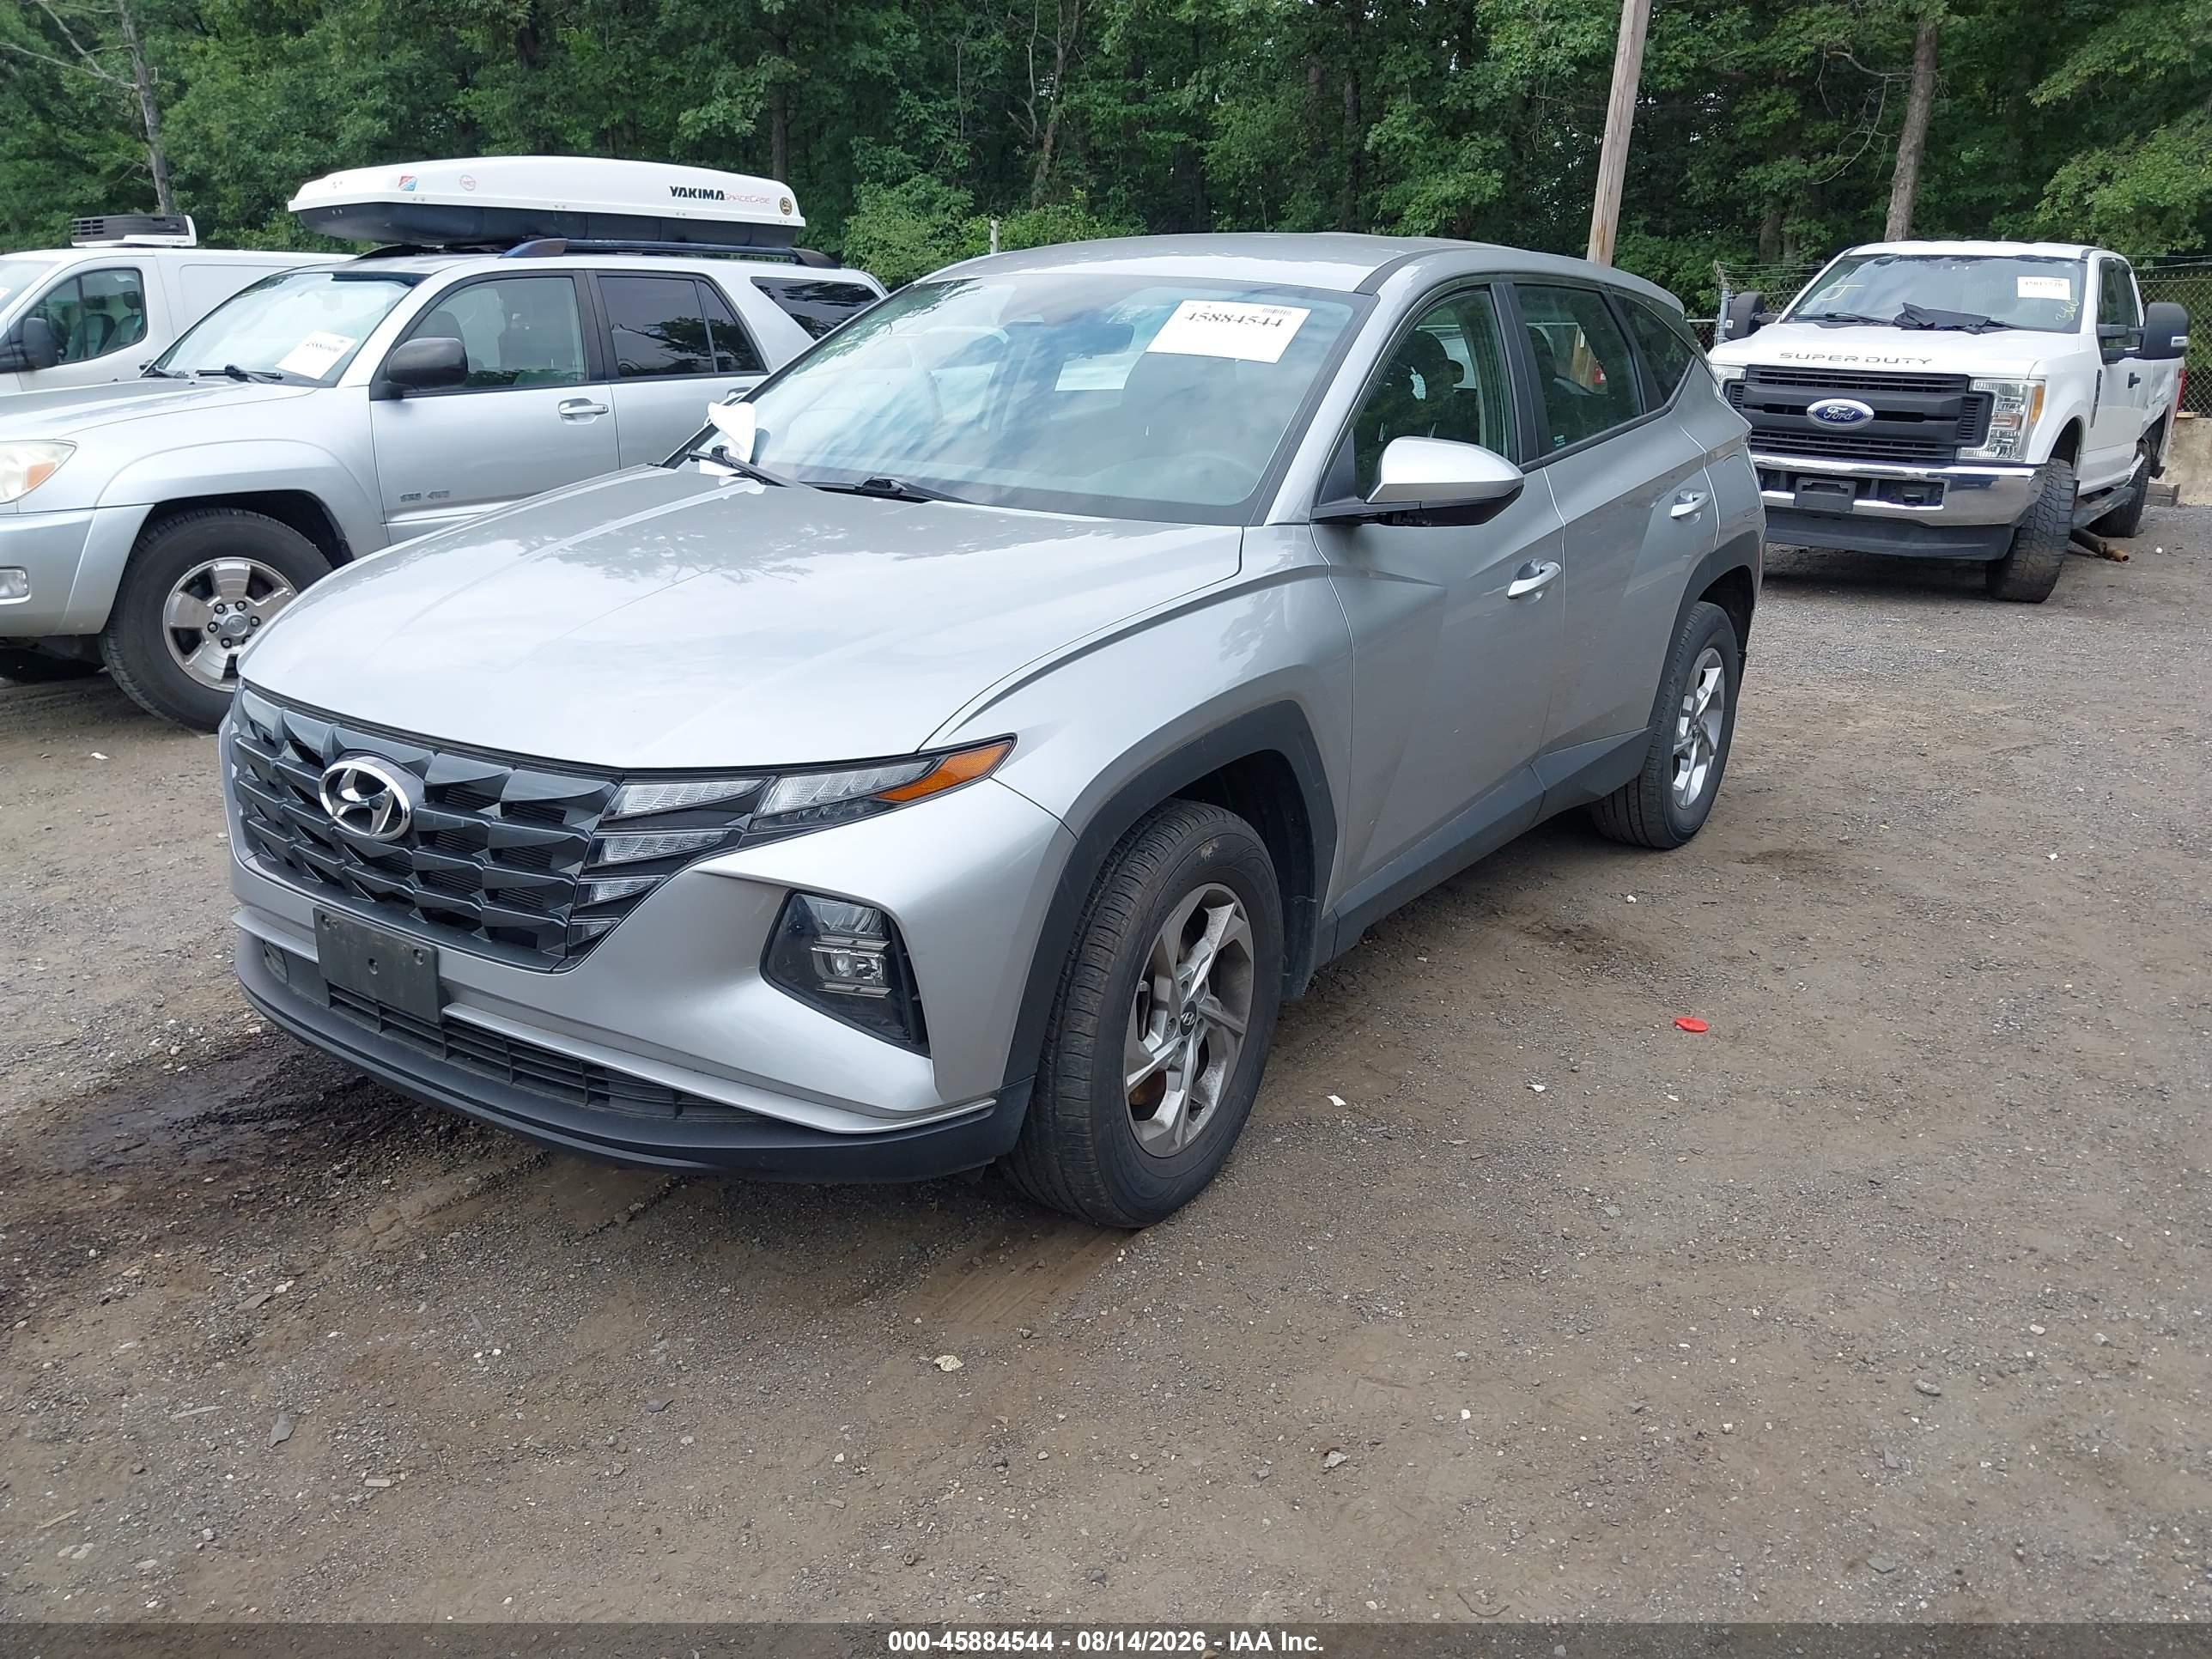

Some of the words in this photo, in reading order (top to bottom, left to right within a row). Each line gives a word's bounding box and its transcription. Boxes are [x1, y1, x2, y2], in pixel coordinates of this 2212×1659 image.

[669, 185, 725, 201] YAKIMA
[1184, 312, 1284, 327] 45884544
[1779, 352, 1859, 362] SUPER
[1865, 356, 1932, 365] DUTY
[1823, 405, 1856, 421] Ford
